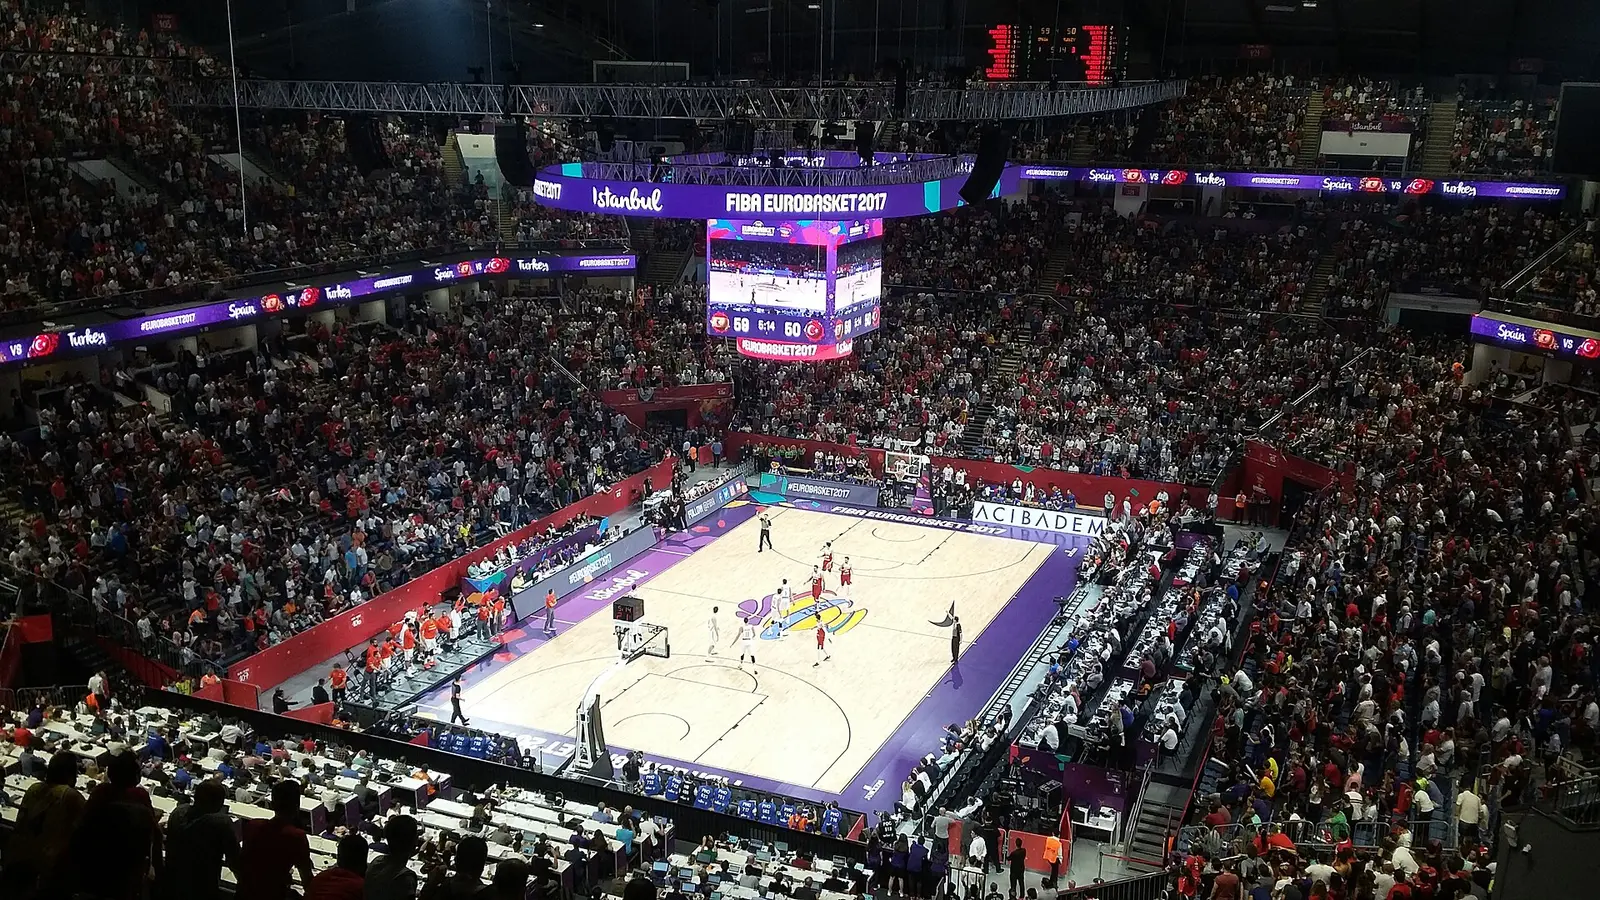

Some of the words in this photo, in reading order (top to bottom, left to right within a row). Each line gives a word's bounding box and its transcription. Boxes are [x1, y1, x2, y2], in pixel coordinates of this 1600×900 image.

[1088, 169, 1117, 182] Spain
[1194, 173, 1226, 187] Turkey
[1322, 178, 1353, 191] Spain
[1441, 181, 1477, 197] Turkey
[592, 186, 663, 212] Istanbul
[726, 193, 761, 212] FIBA
[434, 269, 455, 281] Spain
[517, 259, 550, 271] Turkey
[324, 285, 351, 299] Turkey
[228, 303, 256, 319] Spain
[66, 328, 107, 347] Turkey
[1497, 324, 1527, 343] Spain
[741, 339, 818, 356] #EUROBASKET2017
[787, 483, 850, 499] #EUROBASKET2017
[831, 506, 867, 516] FIBA
[865, 510, 967, 529] EUROBASKET
[965, 523, 1008, 535] 2017
[568, 552, 612, 584] #EUROBASKET2017
